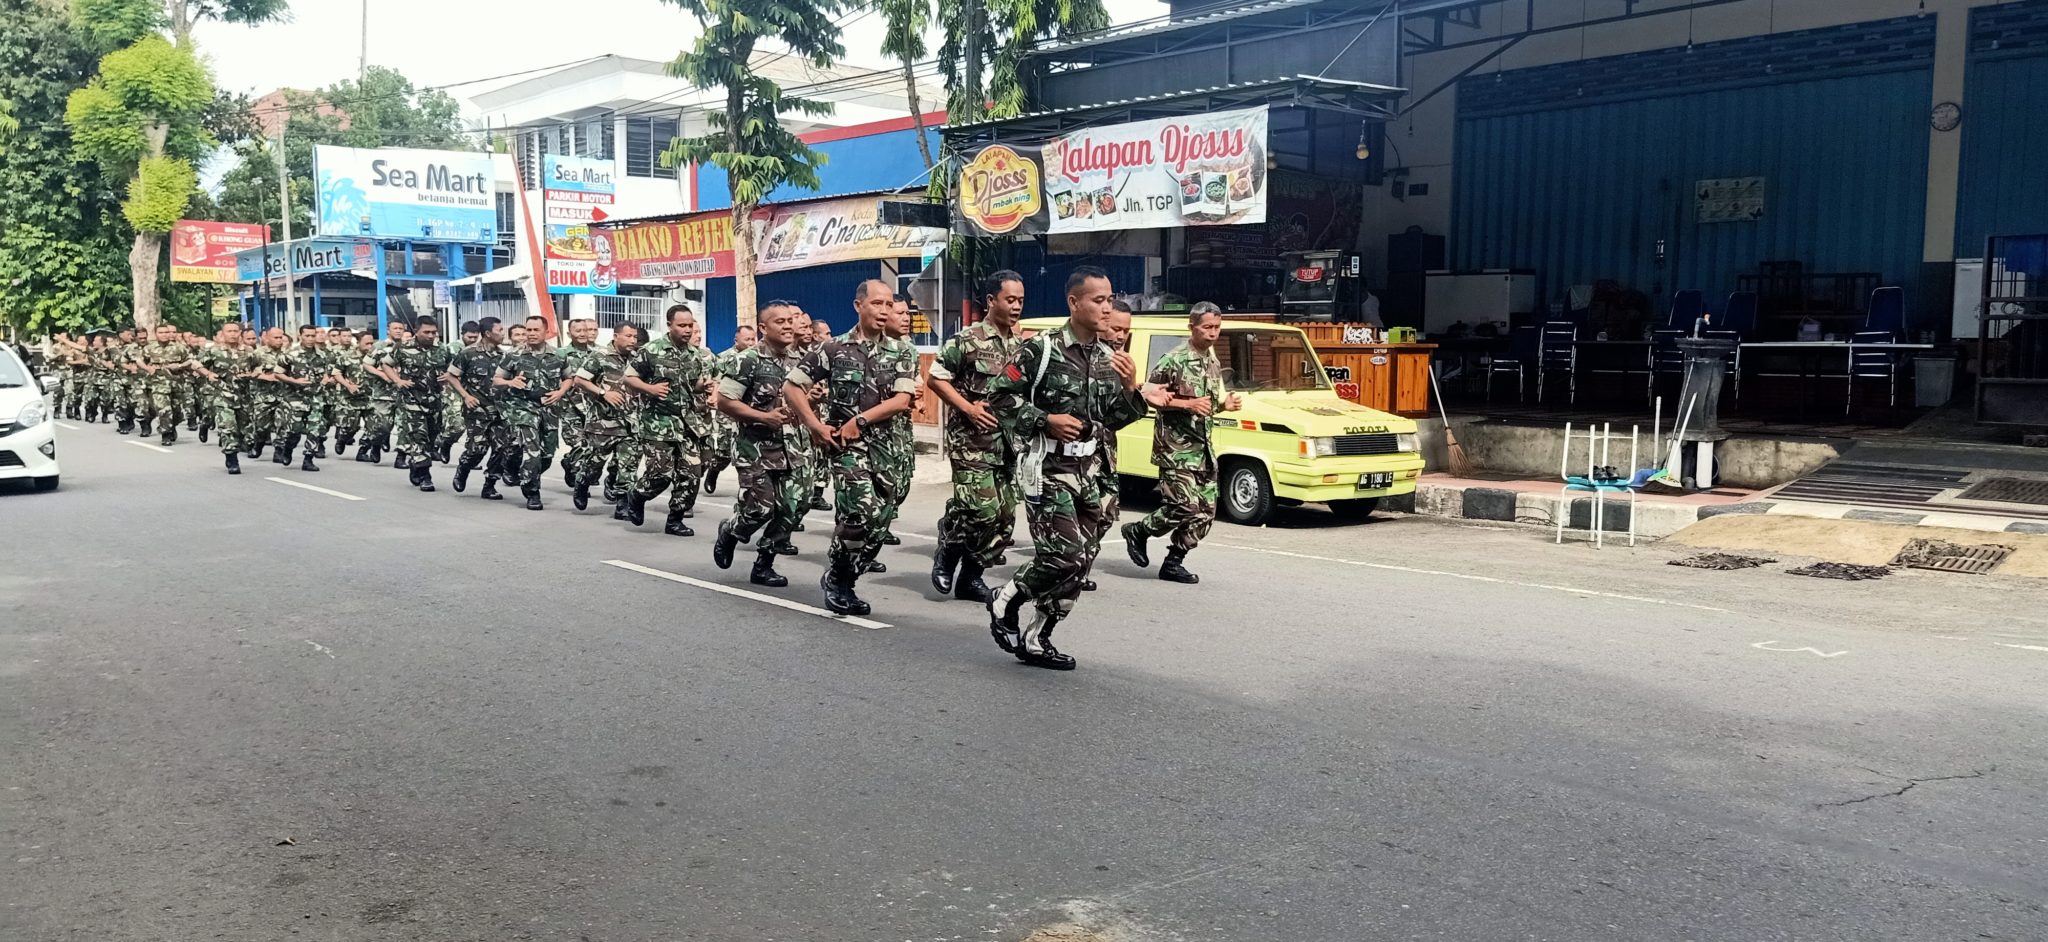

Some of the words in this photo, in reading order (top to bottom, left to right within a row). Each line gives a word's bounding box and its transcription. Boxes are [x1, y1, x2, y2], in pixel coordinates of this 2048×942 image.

[981, 150, 1011, 165] LALAPAN
[1058, 137, 1155, 184] Lalapan
[1160, 124, 1245, 174] Djosss
[371, 159, 418, 189] Sea
[425, 163, 487, 195] Mart
[555, 164, 578, 182] Sea
[583, 168, 611, 185] Mart
[418, 193, 455, 205] belanja
[458, 196, 488, 206] hemat
[548, 190, 580, 202] PARKIR
[582, 192, 612, 204] MOTOR
[966, 168, 1027, 217] Djosss
[1123, 198, 1144, 213] Jln.
[1149, 195, 1174, 211] TGP
[550, 208, 593, 220] MASUK
[612, 224, 673, 261] BAKSO
[676, 216, 736, 257] REJEK
[296, 246, 342, 269] Mart
[177, 267, 213, 276] SWALAYAN
[549, 269, 588, 287] BUKA
[1343, 425, 1390, 435] TOYOTA
[1359, 474, 1368, 485] AG
[1385, 472, 1393, 483] LE
